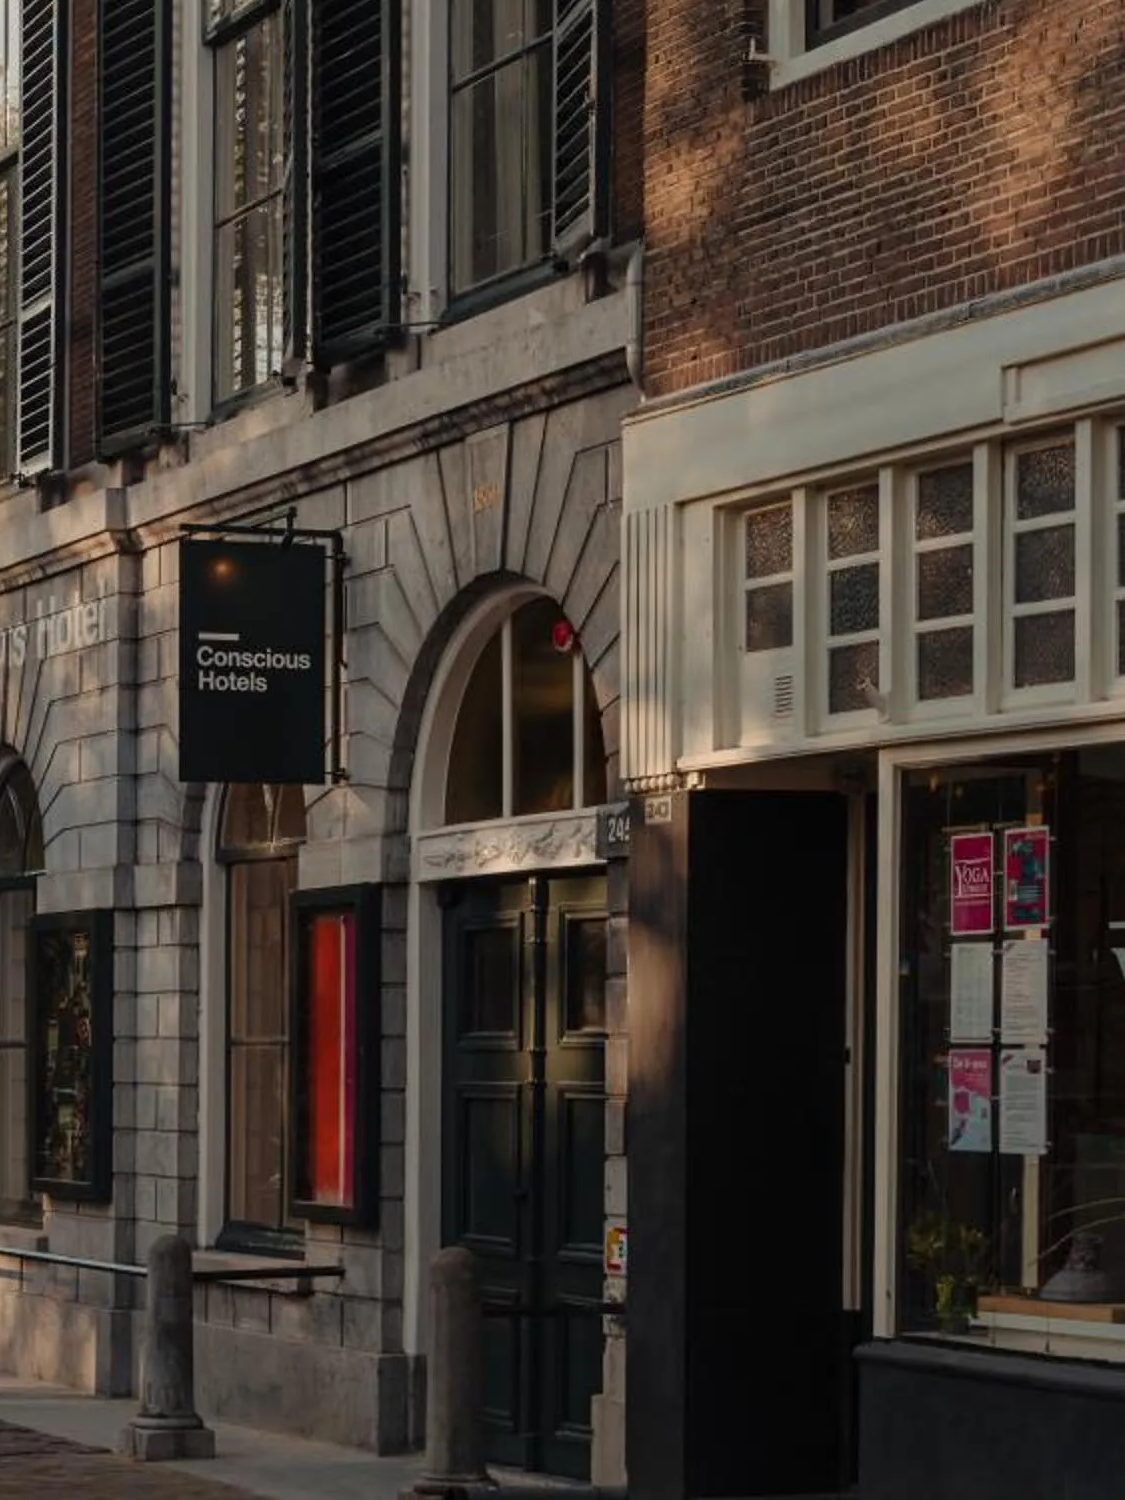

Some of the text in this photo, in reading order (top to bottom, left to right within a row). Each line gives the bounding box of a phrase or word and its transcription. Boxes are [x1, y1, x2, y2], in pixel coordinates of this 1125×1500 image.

[36, 583, 107, 659] Hotel
[196, 645, 312, 669] Conscious
[198, 669, 268, 692] Hotels
